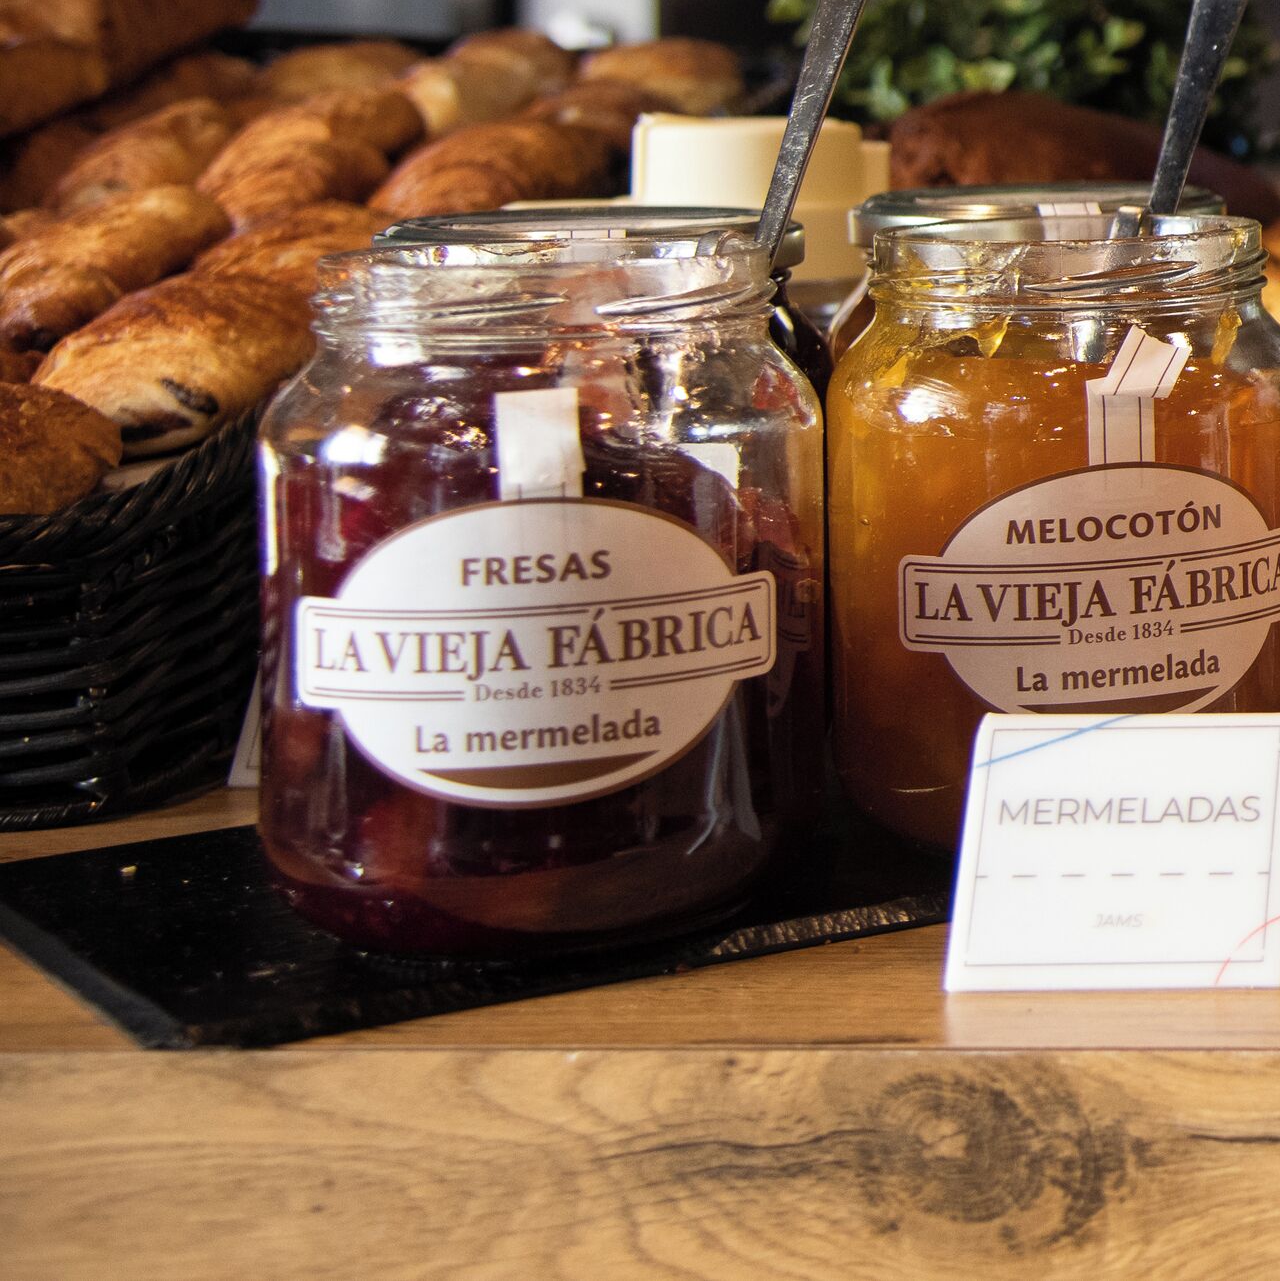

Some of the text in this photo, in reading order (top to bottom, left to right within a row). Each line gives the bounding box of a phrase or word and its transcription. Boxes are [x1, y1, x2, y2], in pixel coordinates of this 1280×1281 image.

[1006, 501, 1222, 545] MELOCOTÓN
[460, 549, 612, 587] FRESAS
[914, 581, 973, 621] LA
[975, 579, 1118, 627] VIEJA
[314, 601, 762, 681] LA VIEJA FÁBRICA
[1068, 621, 1175, 646] Desde 1834
[473, 675, 602, 703] Desde 1834
[1016, 649, 1220, 692] La mermelada
[415, 708, 662, 753] La mermelada
[998, 795, 1262, 825] MERMELADAS
[1093, 913, 1145, 929] JAMS
